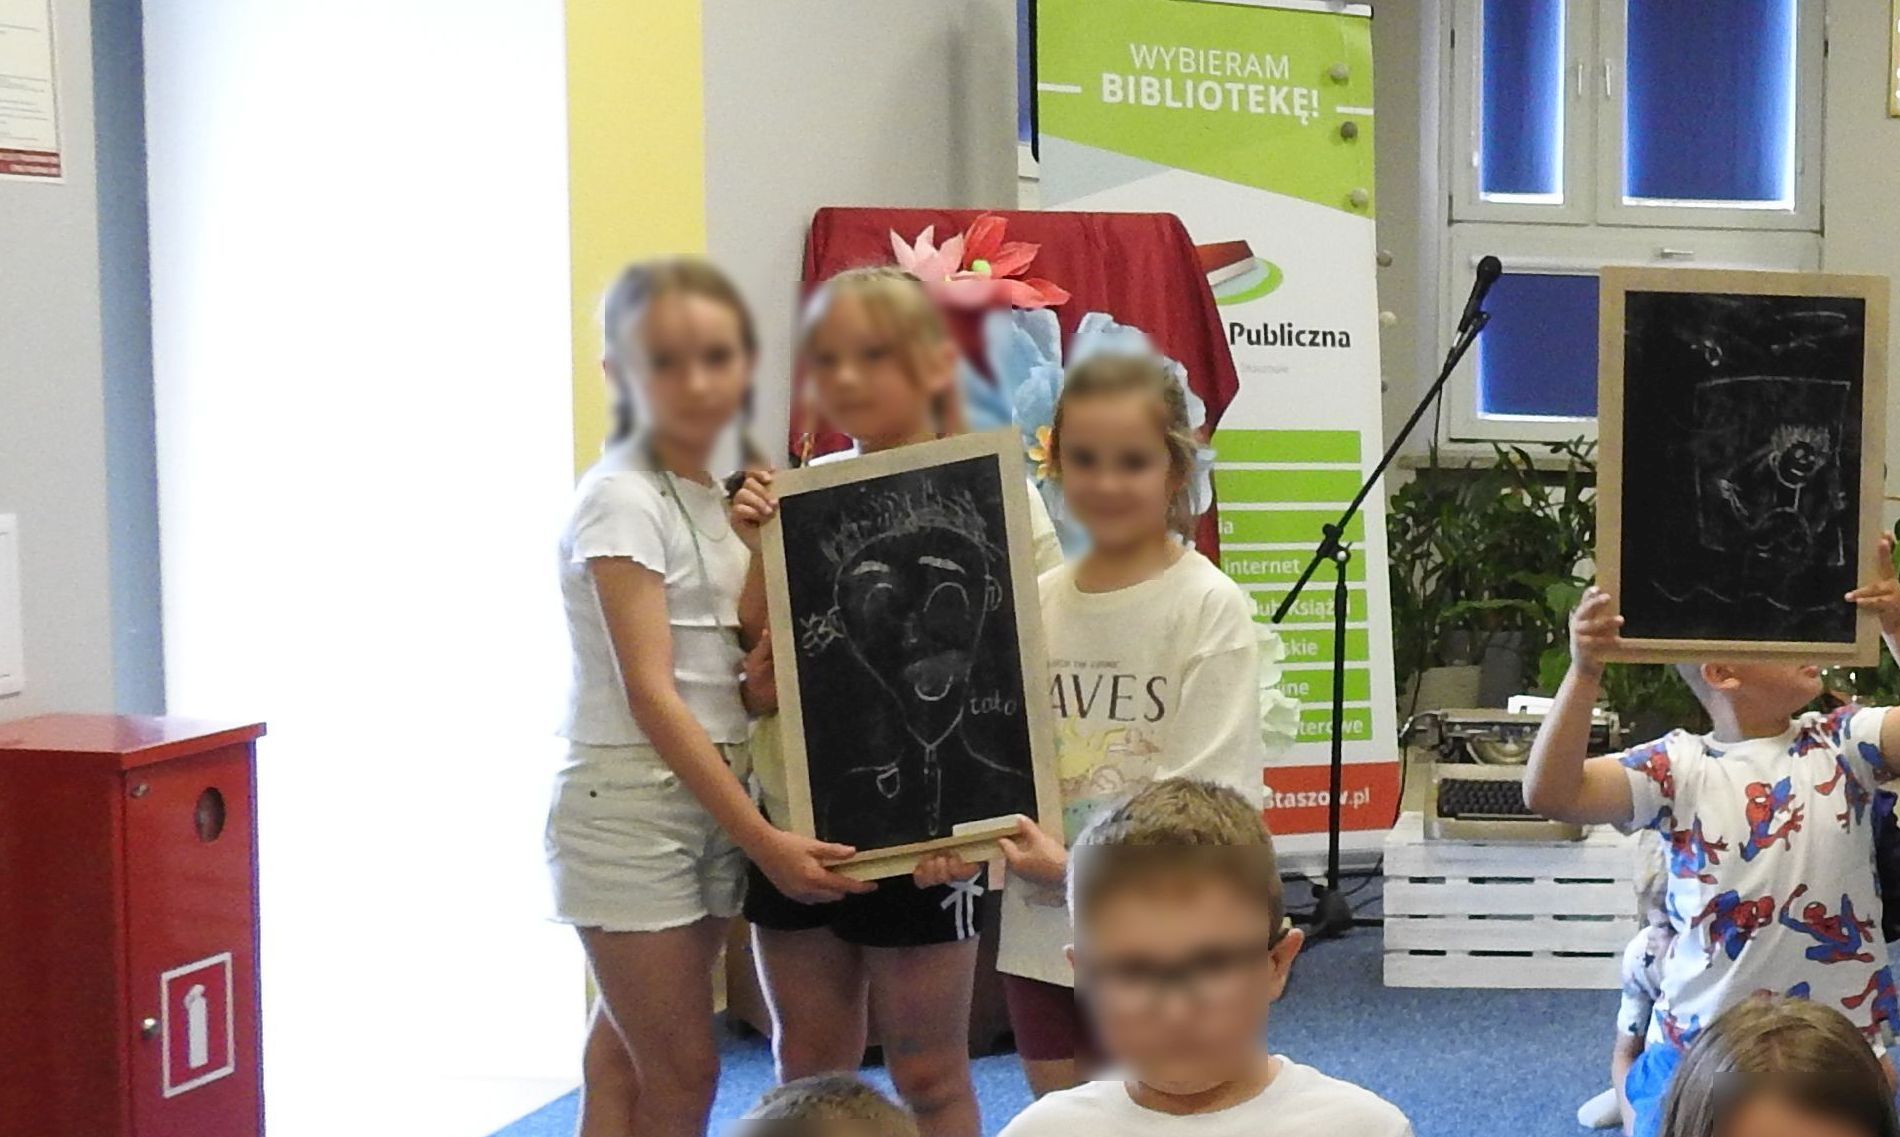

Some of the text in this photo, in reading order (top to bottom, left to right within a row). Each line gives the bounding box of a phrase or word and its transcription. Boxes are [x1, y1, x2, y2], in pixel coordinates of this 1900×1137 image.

[1129, 43, 1290, 81] WYBIERAM
[1101, 73, 1320, 126] BIBLIOTEKĘ!
[1229, 321, 1351, 348] Publiczna
[1049, 673, 1168, 722] AVES
